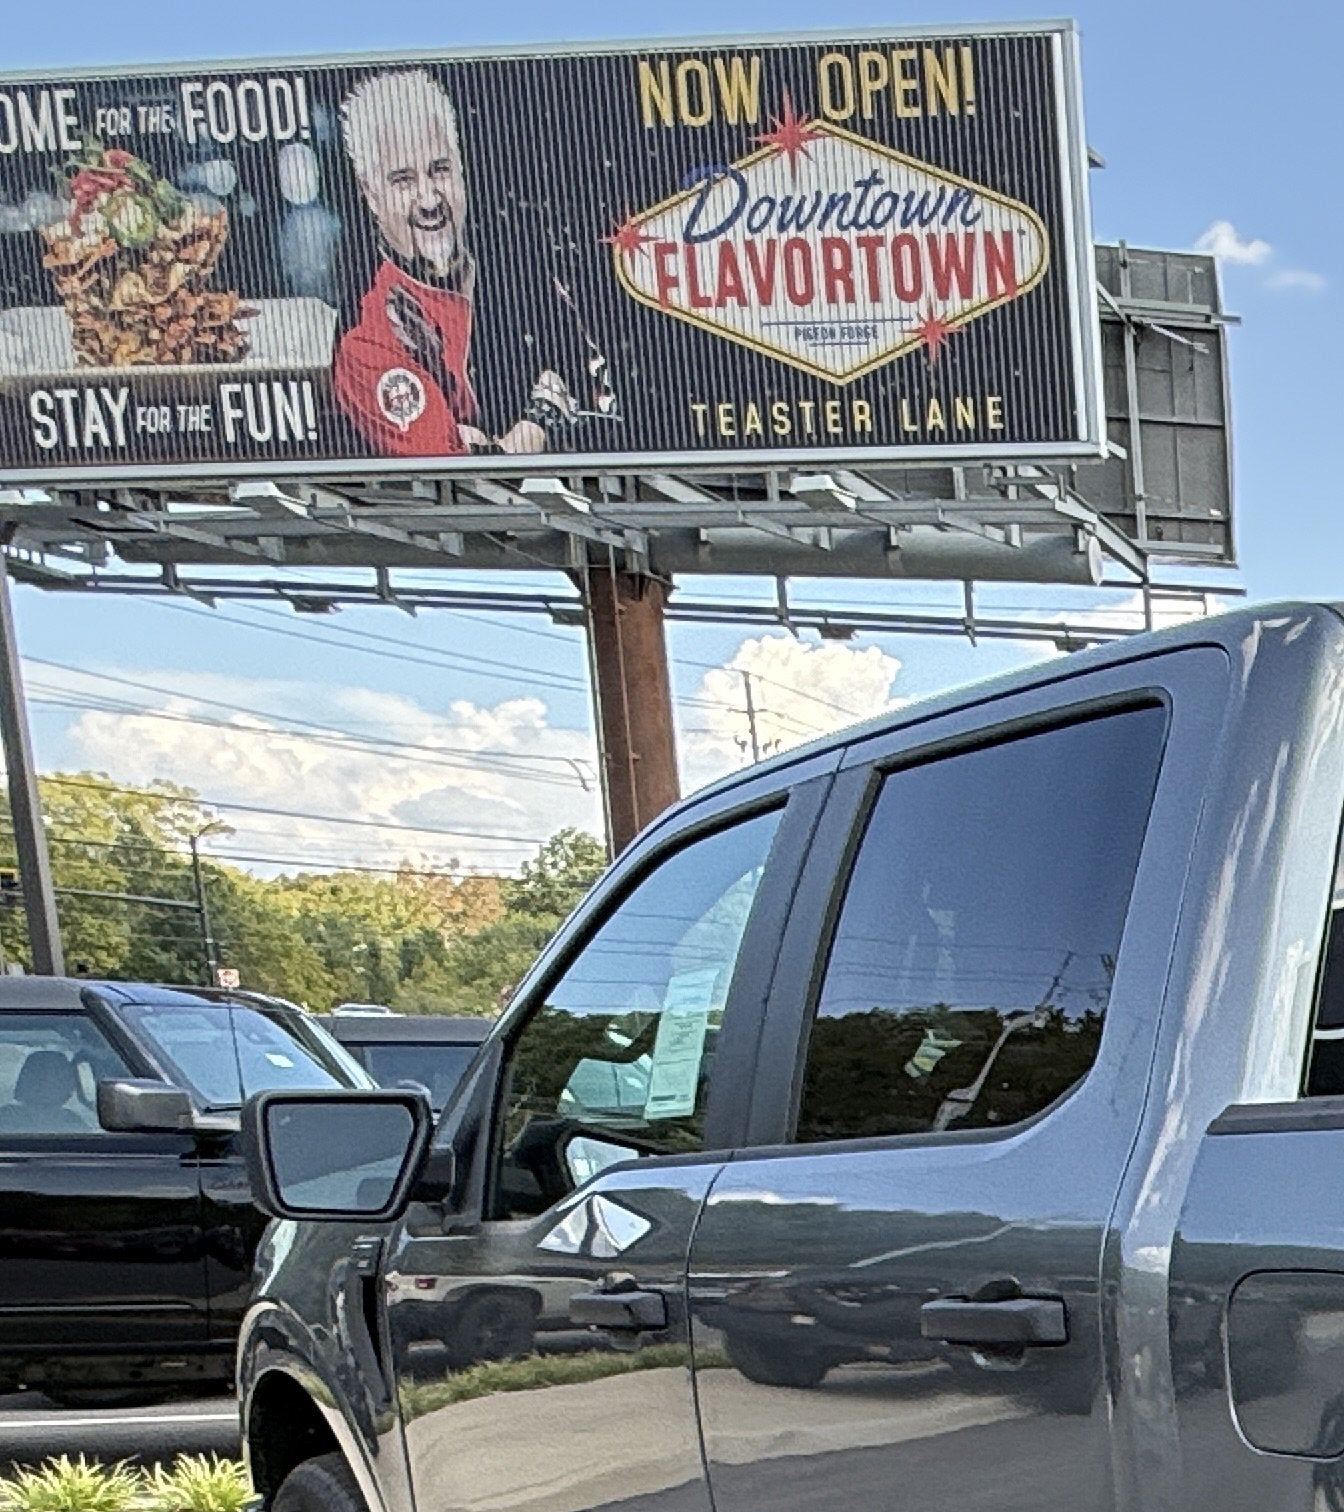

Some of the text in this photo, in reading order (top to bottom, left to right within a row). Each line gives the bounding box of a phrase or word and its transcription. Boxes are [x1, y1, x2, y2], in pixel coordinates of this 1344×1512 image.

[0, 77, 311, 154] OME FOR THE FOOD!
[638, 46, 977, 129] NOW OPEN!
[681, 164, 982, 245] Downtown
[653, 230, 1019, 309] FLAVORTOWN
[29, 380, 318, 449] STAY FOR THE FUN!
[692, 395, 1004, 437] TEASTER LANE
